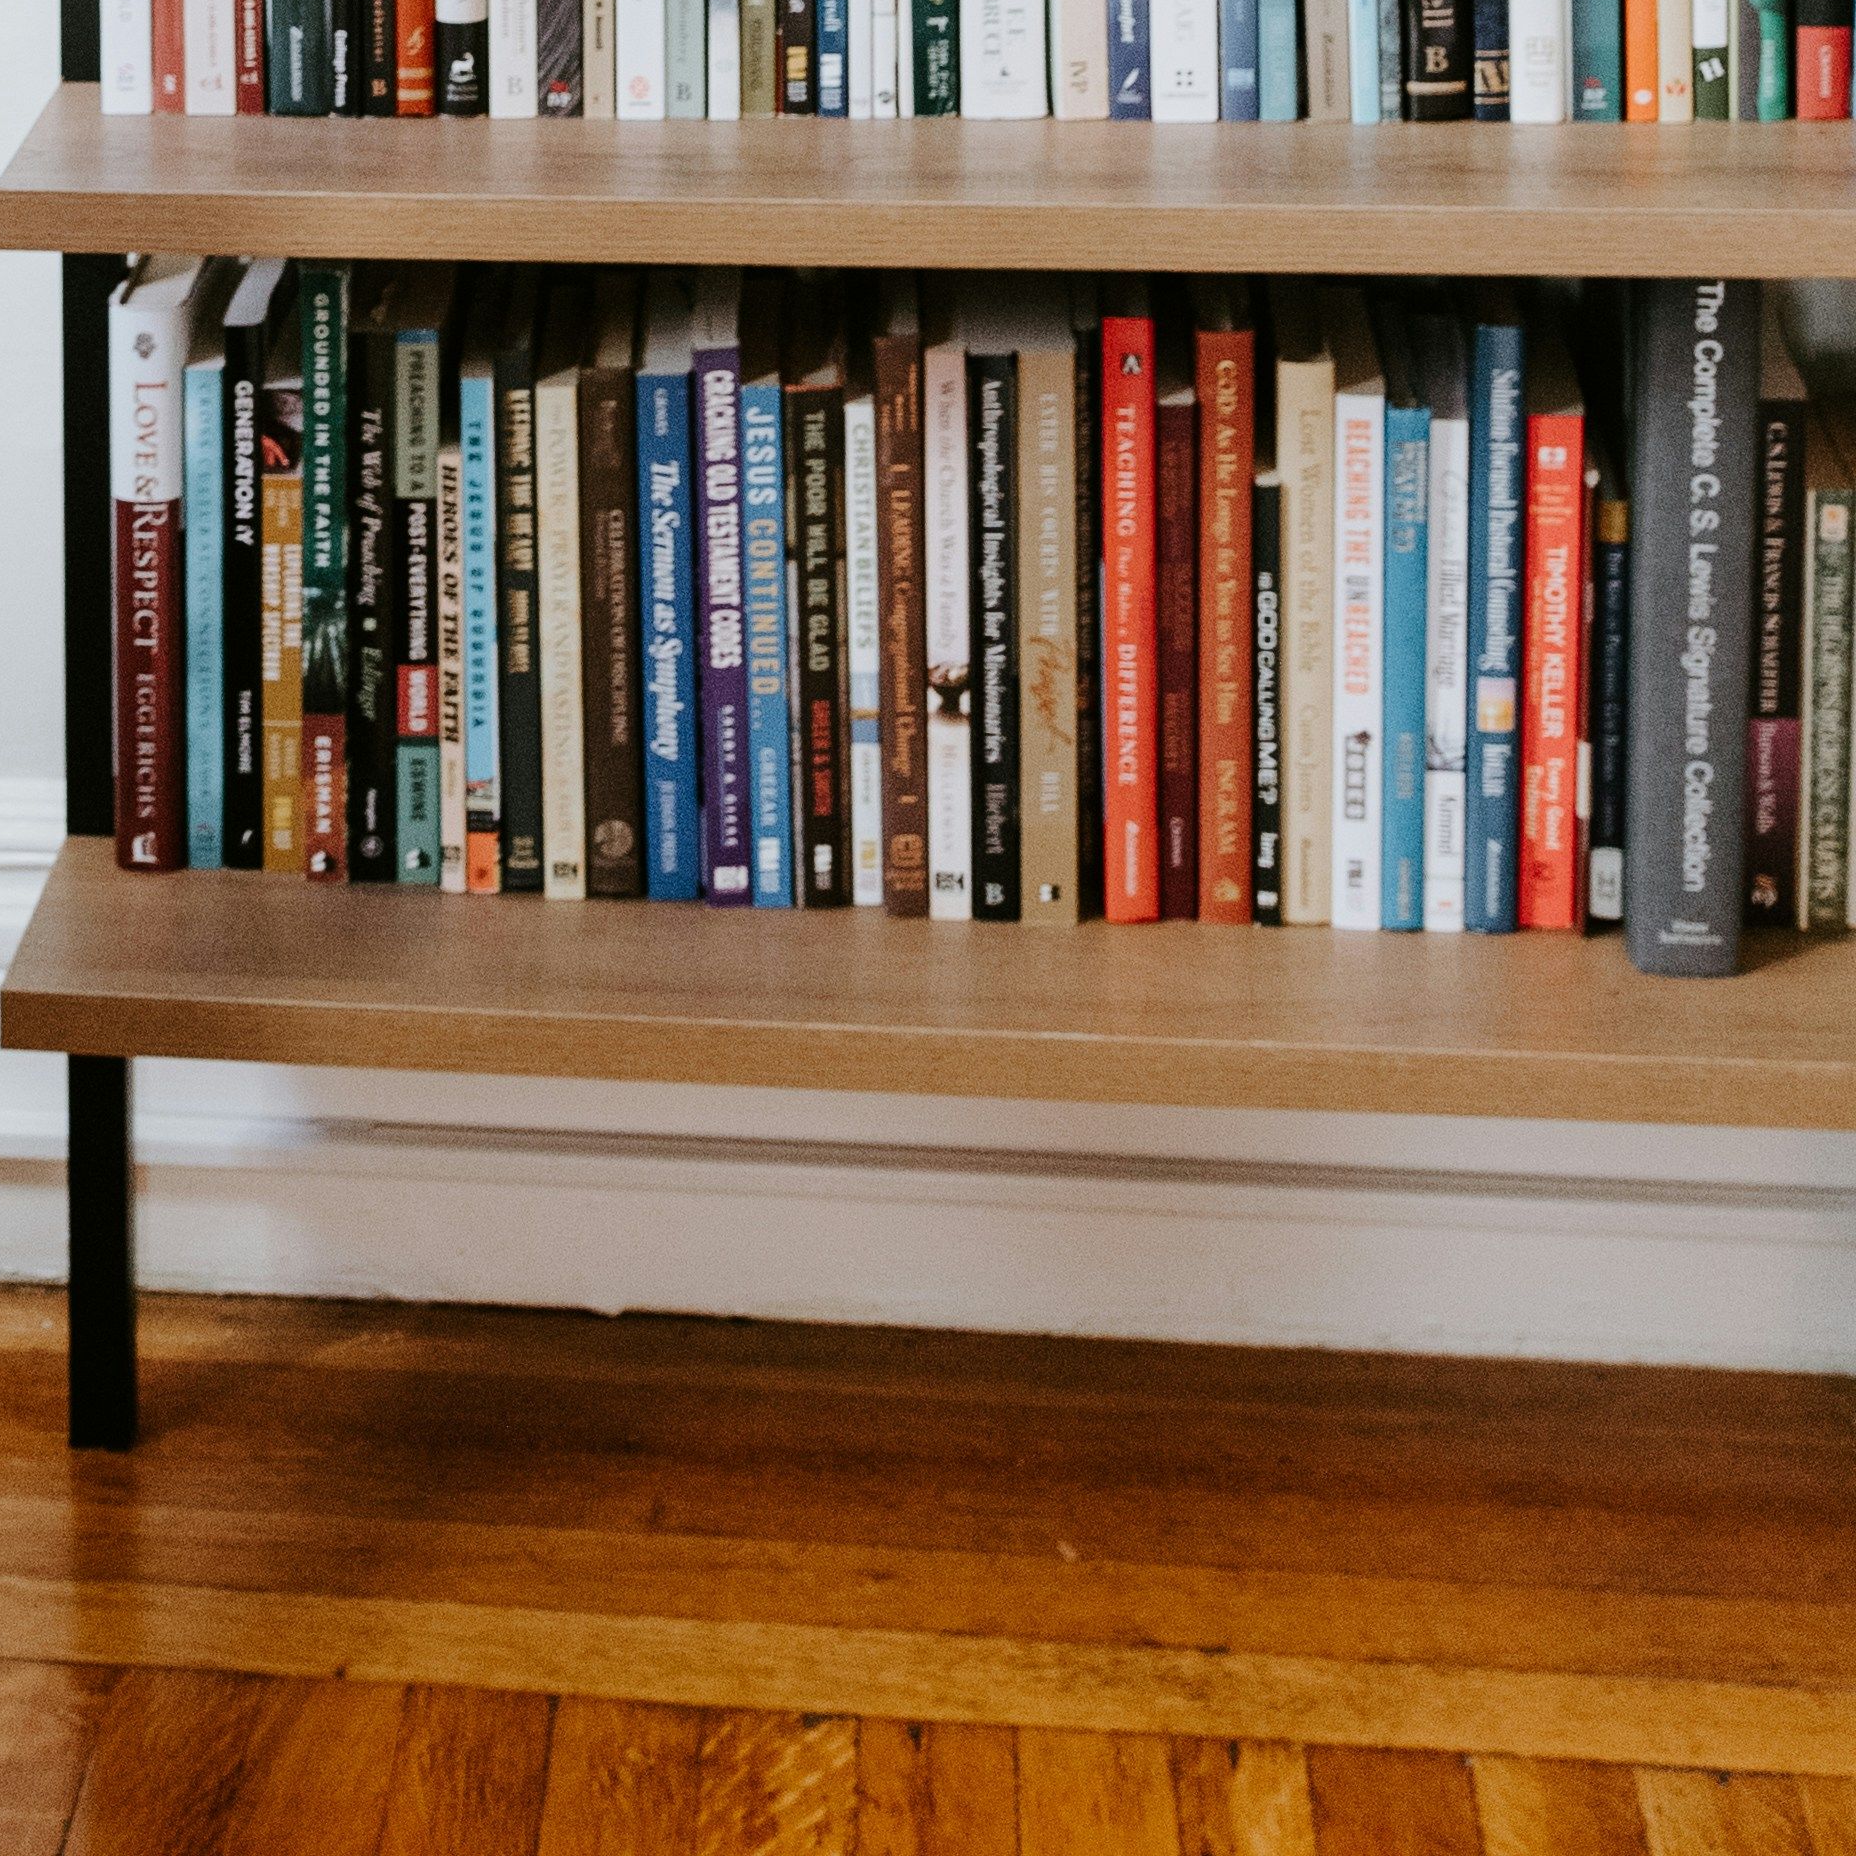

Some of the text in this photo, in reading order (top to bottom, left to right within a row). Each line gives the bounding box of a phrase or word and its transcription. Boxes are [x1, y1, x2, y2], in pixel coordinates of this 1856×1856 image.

[132, 380, 169, 468] LOVE
[233, 380, 254, 518] GENERATION
[745, 405, 777, 507] JESUS
[1116, 403, 1138, 537] TEACHING
[132, 502, 169, 653] RESPECT
[408, 503, 429, 661] POST-EVERYTHING
[703, 369, 743, 670] CRACKING OLD TESTAMENT CODES
[851, 422, 875, 649] CHRISTIAN BELIEFS
[1682, 281, 1724, 892] The Complete C. S. Lewis Signature Collection
[440, 463, 461, 745] HEROES OF THE FAITH
[1541, 546, 1568, 738] TIMOTHY KELLER
[1116, 643, 1138, 787] DIFFERENCE
